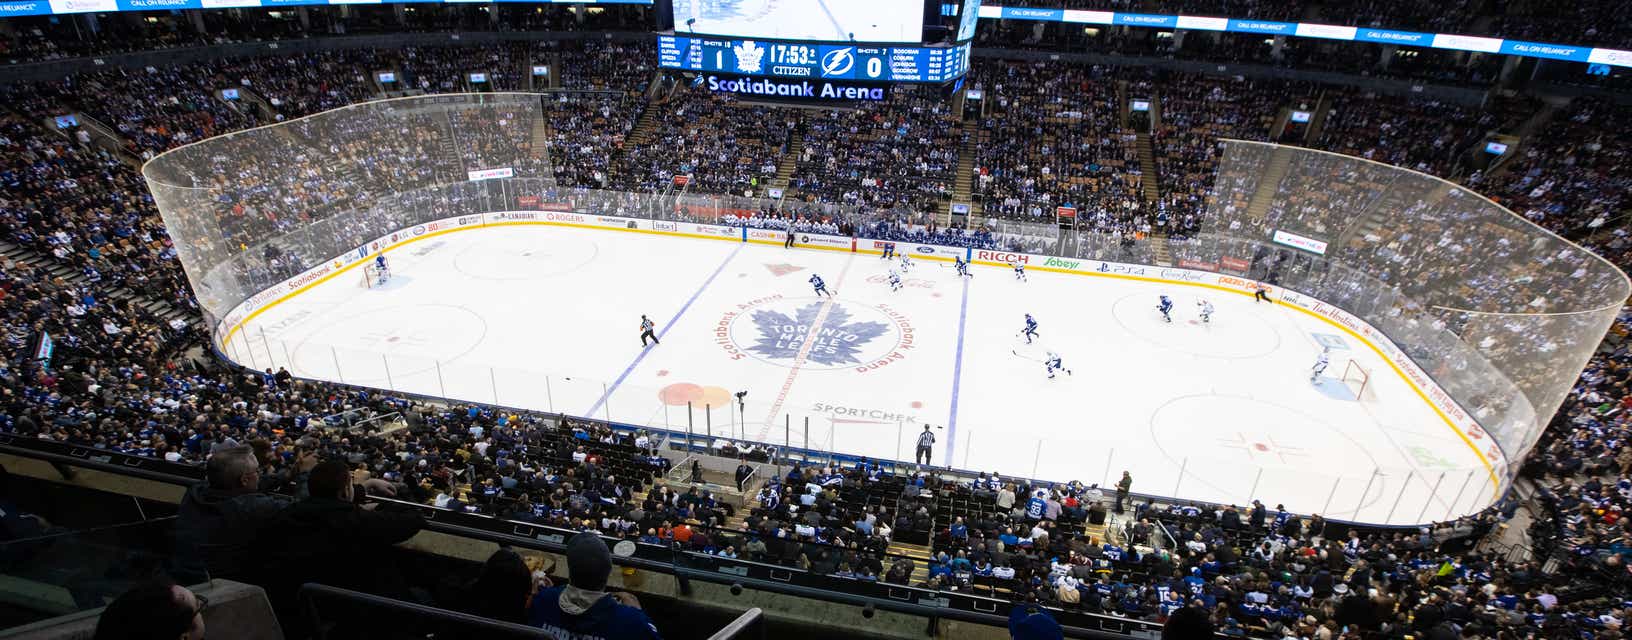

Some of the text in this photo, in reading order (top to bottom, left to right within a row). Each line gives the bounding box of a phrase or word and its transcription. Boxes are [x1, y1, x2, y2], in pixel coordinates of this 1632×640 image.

[716, 50, 722, 70] 1
[770, 44, 808, 64] 17:53
[810, 48, 816, 57] 2
[773, 66, 811, 76] CITIZEN
[867, 57, 882, 78] 0
[708, 76, 883, 100] Scotiabank Arena
[556, 214, 584, 222] ROGERS
[289, 266, 330, 290] Scotiabank
[1114, 267, 1144, 276] PS4
[1246, 282, 1272, 293] pia
[1312, 302, 1328, 314] Tim
[714, 294, 784, 362] Scotiabank Arena
[776, 340, 838, 354] LEFS
[856, 303, 916, 374] Scotiabank Arena
[812, 402, 917, 424] SPORTCHEK
